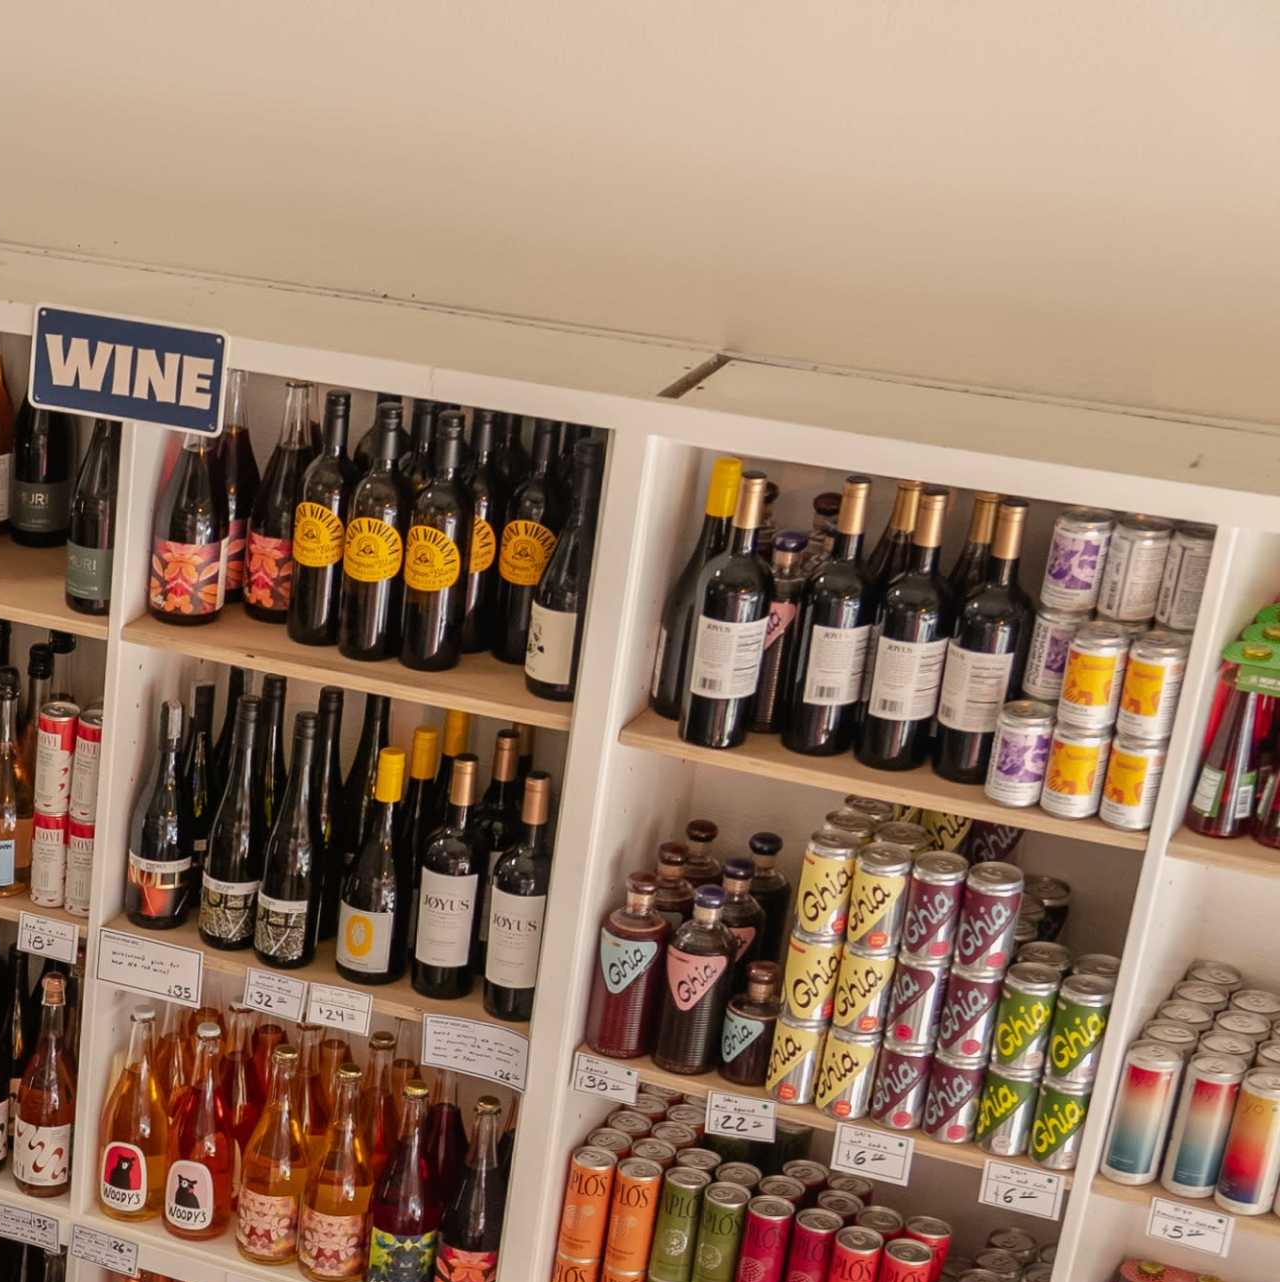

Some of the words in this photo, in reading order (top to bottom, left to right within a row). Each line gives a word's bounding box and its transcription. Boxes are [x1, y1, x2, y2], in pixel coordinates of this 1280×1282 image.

[44, 333, 215, 411] WINE
[803, 863, 854, 922] Ghia
[848, 882, 891, 931] Ghia
[904, 891, 955, 946] Ghia
[958, 902, 1010, 956] Ghia
[607, 947, 647, 984] Ghia
[676, 962, 719, 1005] Ghia
[793, 953, 842, 1008] Ghia
[836, 968, 884, 1018] Ghia
[941, 986, 988, 1037] Ghia
[722, 1017, 754, 1058] Ghia
[996, 1001, 1050, 1057] Ghia
[1052, 1012, 1105, 1071] Ghia
[873, 1057, 919, 1112] Ghia
[924, 1073, 972, 1127] Ghia
[1033, 1095, 1087, 1154] Ghia
[102, 1186, 140, 1206] WOODY'S
[168, 1204, 207, 1225] WOODY'S
